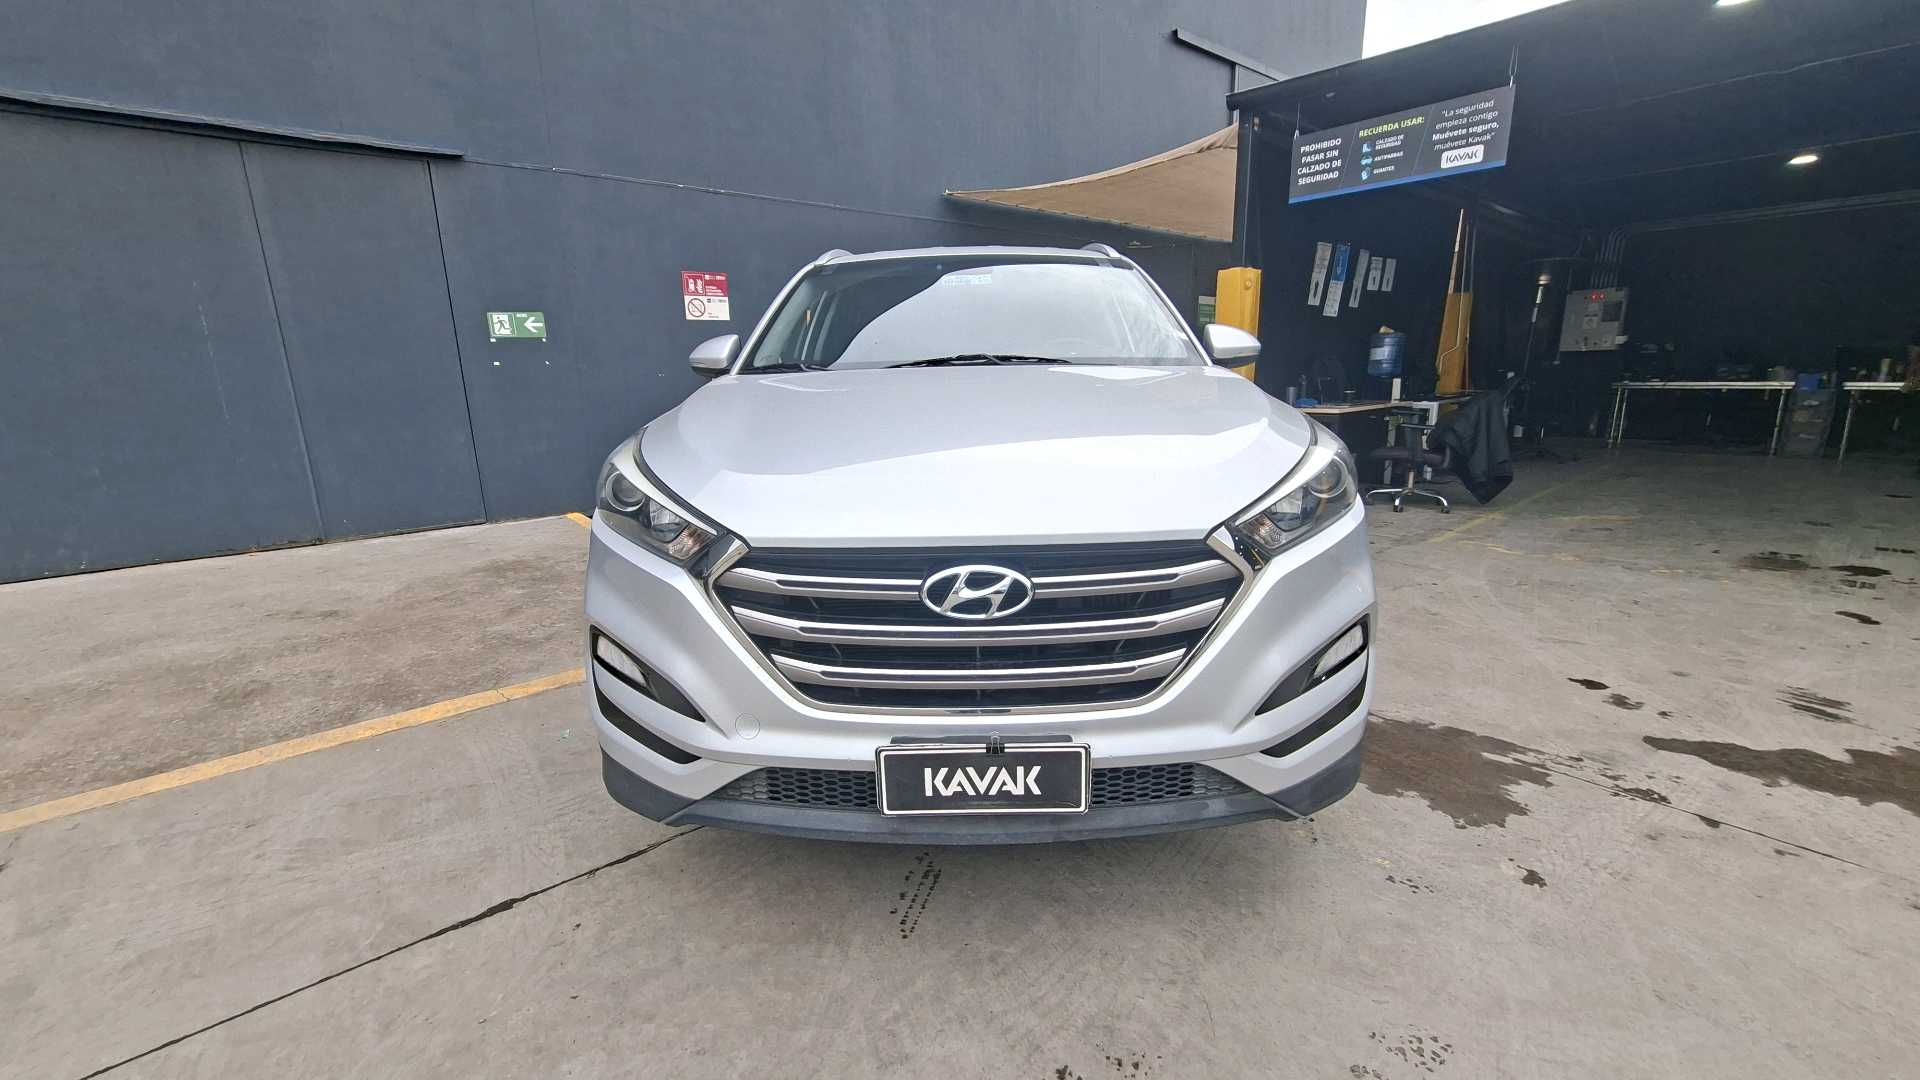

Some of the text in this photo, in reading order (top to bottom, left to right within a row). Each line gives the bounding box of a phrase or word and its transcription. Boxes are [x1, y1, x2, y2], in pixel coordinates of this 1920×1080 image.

[1455, 99, 1496, 115] seguridad
[1359, 116, 1425, 138] RECUERDA USAR:
[1435, 111, 1498, 130] empieza contigo
[1432, 121, 1500, 141] Muévete seguro,
[1300, 137, 1342, 153] PROHIBIDO
[1434, 138, 1467, 151] muévete
[1301, 149, 1339, 164] PASAR SIN
[1446, 149, 1480, 164] KAVAK
[1297, 158, 1342, 175] CALZADO DE
[1297, 170, 1339, 185] SEGURIDAD
[924, 765, 1042, 797] KAVAK
